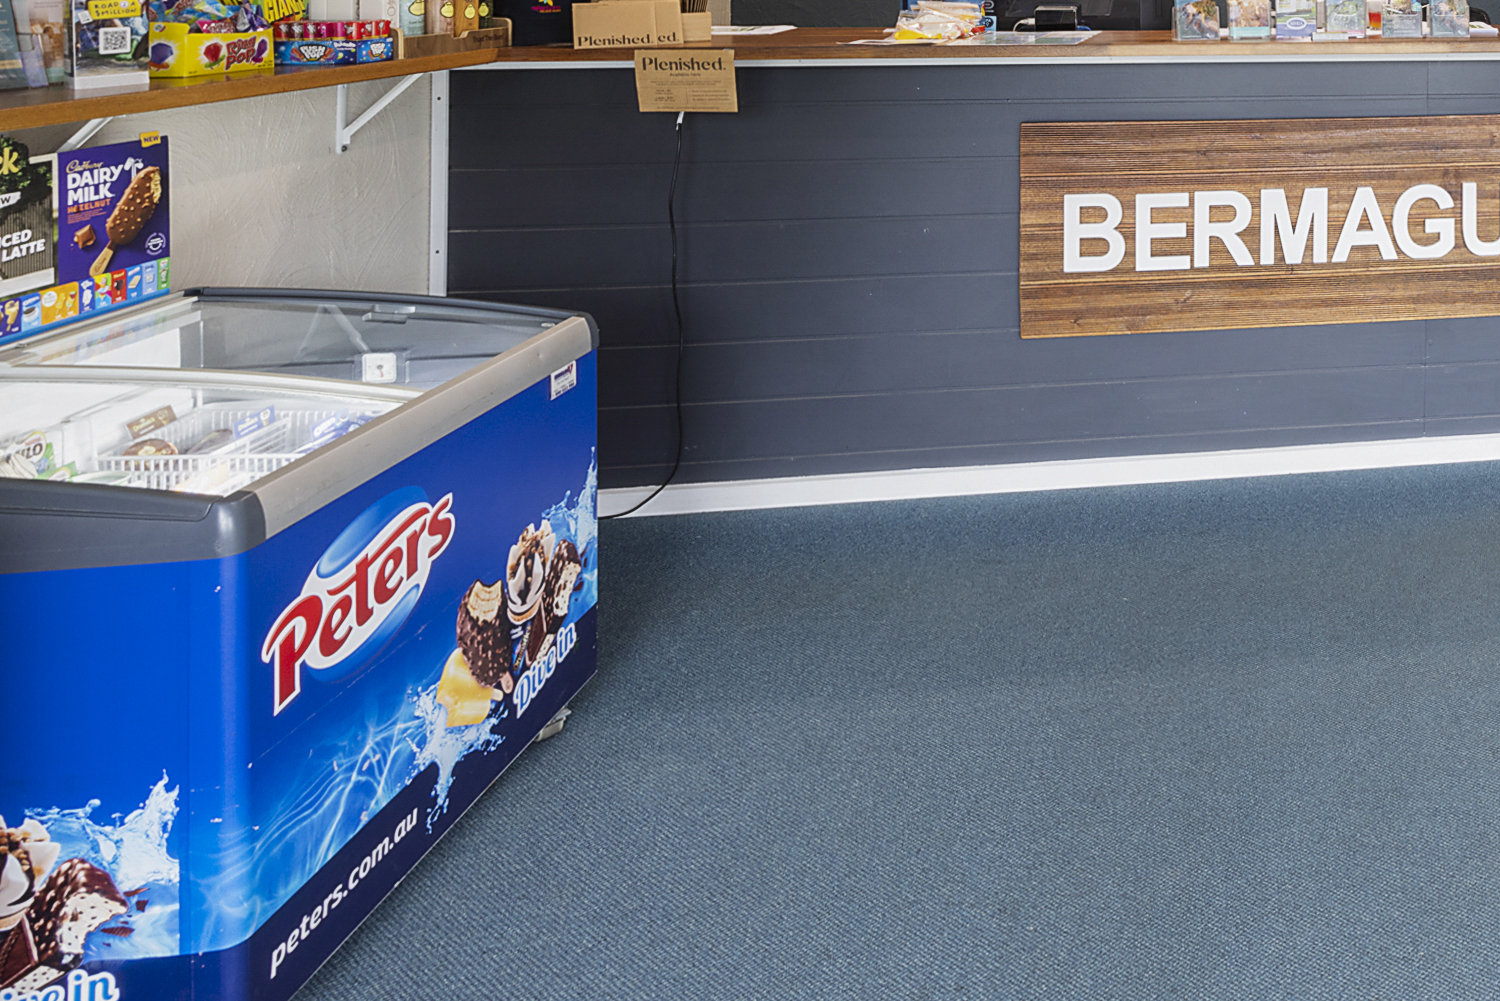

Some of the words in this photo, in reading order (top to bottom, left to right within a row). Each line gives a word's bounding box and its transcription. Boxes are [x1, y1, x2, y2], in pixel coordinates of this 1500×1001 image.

[577, 32, 654, 48] Plenished.
[641, 56, 727, 72] Plenished.
[143, 135, 160, 144] NEW
[67, 165, 124, 189] DAIRY
[68, 183, 116, 206] MILK
[2, 238, 46, 262] LATTE
[261, 492, 456, 717] Peters
[513, 645, 557, 719] Dive
[556, 622, 577, 663] in
[268, 806, 418, 979] peters.com.au
